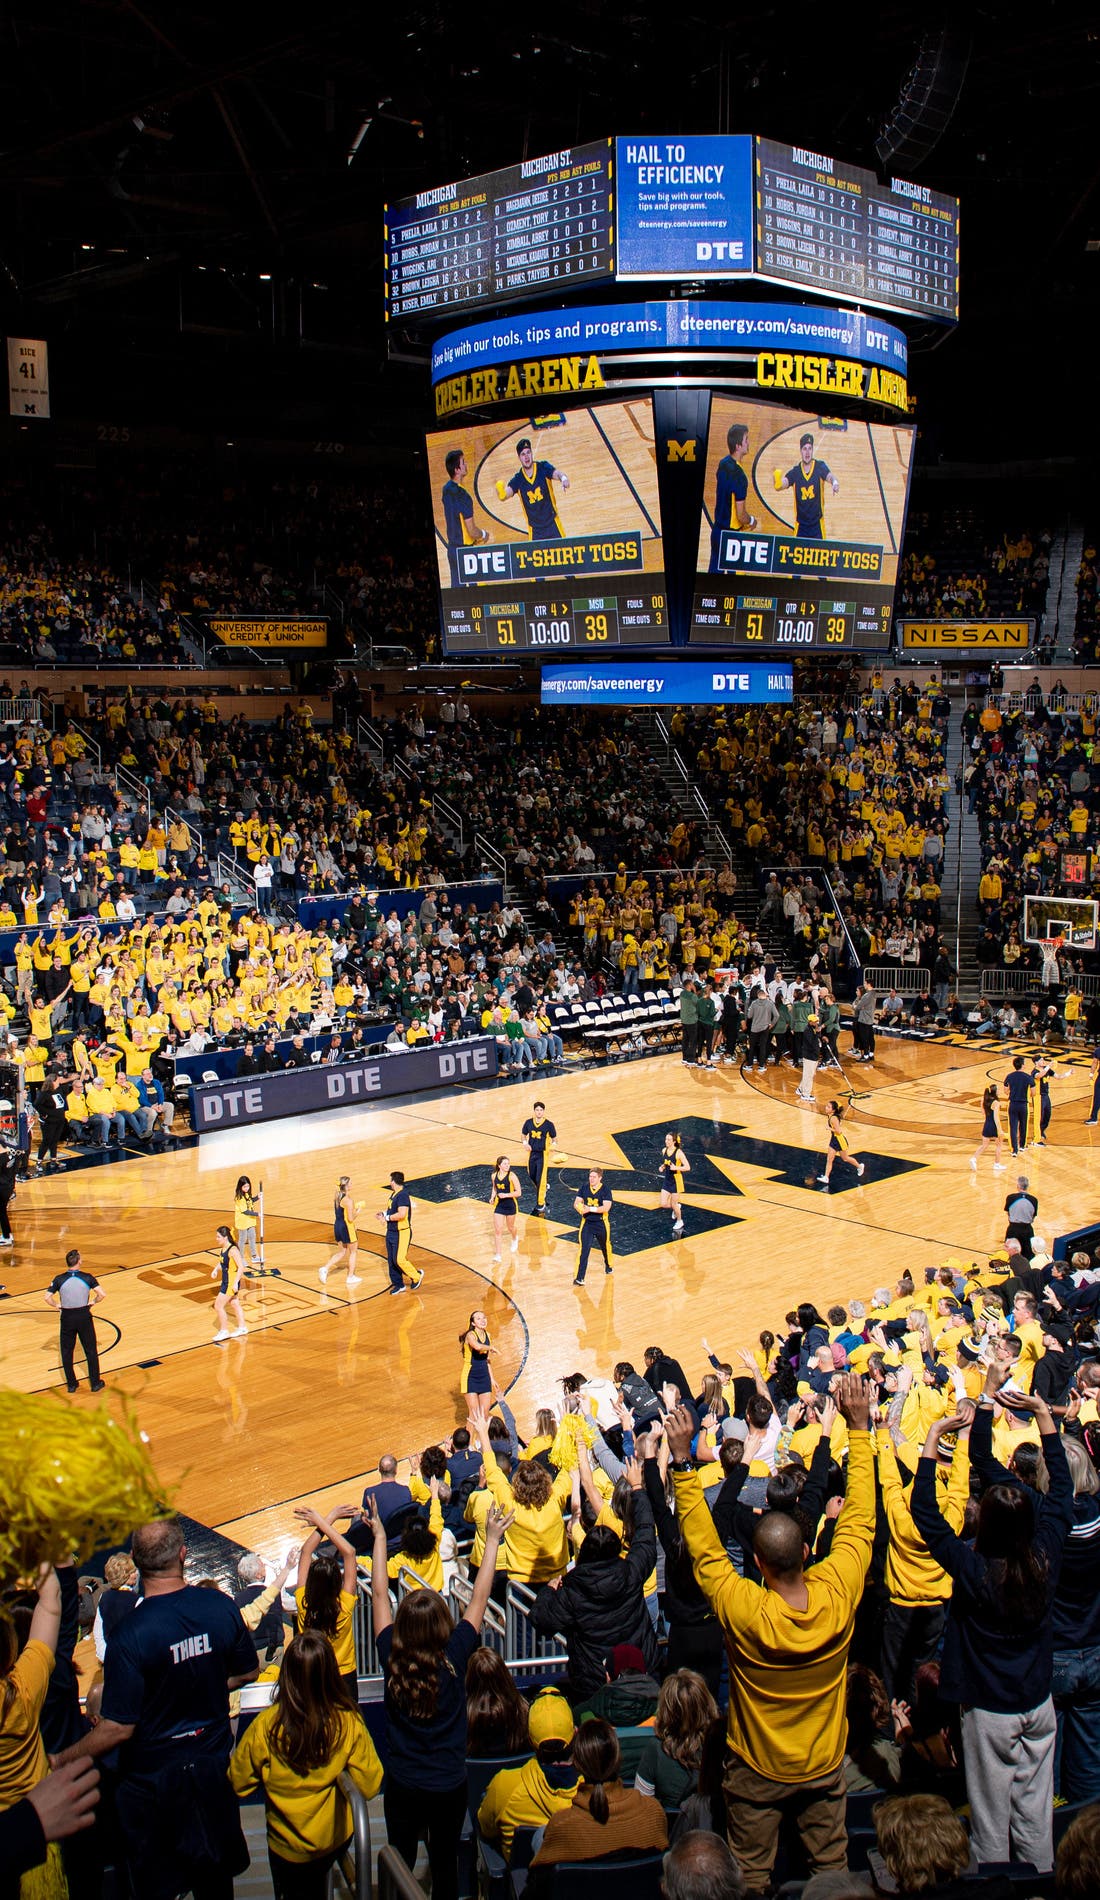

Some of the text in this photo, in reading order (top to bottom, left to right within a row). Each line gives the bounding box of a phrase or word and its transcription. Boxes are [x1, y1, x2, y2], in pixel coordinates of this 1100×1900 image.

[521, 150, 573, 179] MICHIGAN ST.
[626, 145, 685, 164] HAIL TO
[792, 146, 834, 174] MICHIGAN
[547, 173, 558, 184] PTS
[571, 166, 582, 177] AST
[584, 160, 601, 173] FOULS
[638, 165, 724, 185] EFFICIENCY
[416, 183, 457, 209] MICHIGAN
[495, 178, 596, 217] 0 2 2 2 1
[638, 193, 656, 201] Save
[658, 192, 669, 202] big
[671, 192, 688, 200] with
[704, 191, 726, 200] tools,
[765, 174, 769, 186] 5
[818, 190, 825, 201] 10
[829, 193, 834, 204] 3
[841, 196, 845, 208] 2
[851, 199, 856, 211] 2
[890, 177, 932, 204] MICHIGAN ST.
[638, 202, 708, 212] tips and programs.
[391, 234, 396, 244] 5
[441, 219, 449, 230] 10
[453, 216, 458, 228] 3
[465, 213, 469, 224] 2
[476, 210, 481, 221] 2
[495, 225, 499, 236] 1
[533, 211, 549, 225] TORY
[553, 210, 558, 220] 2
[565, 206, 570, 218] 2
[578, 203, 582, 214] 1
[591, 200, 597, 211] 2
[638, 220, 727, 229] dteenergy.com/saveenergy
[495, 244, 500, 254] 2
[553, 228, 558, 240] 0
[565, 225, 570, 237] 0
[578, 222, 583, 233] 0
[591, 219, 597, 230] 0
[495, 261, 500, 271] 5
[552, 246, 560, 258] 12
[565, 244, 570, 255] 5
[579, 240, 583, 251] 1
[592, 237, 597, 248] 0
[696, 242, 744, 261] DTE
[496, 278, 503, 290] 14
[554, 265, 559, 276] 6
[565, 262, 570, 273] 8
[579, 259, 584, 270] 0
[592, 256, 598, 267] 0
[680, 314, 853, 344] dteenergy.com/saveenergy
[866, 330, 889, 352] DTE
[434, 319, 662, 368] Save big with our tools, tips and programs.
[19, 362, 36, 379] 41
[757, 352, 864, 397] CRISLER
[435, 355, 606, 417] CRISLER ARENA
[24, 404, 36, 414] M
[667, 440, 696, 462] M
[526, 486, 544, 504] M
[800, 484, 815, 500] M
[463, 541, 638, 575] DTE T-SHIRT TOSS
[725, 539, 880, 571] DTE T-SHIRT TOSS
[489, 603, 520, 615] MICHIGAN
[534, 603, 557, 617] QTR 4
[588, 599, 604, 610] MSU
[626, 595, 664, 609] FOULS 00
[701, 597, 734, 610] FOULS 00
[742, 597, 773, 609] MICHIGAN
[785, 602, 806, 616] QTR 4
[862, 606, 890, 618] FOULS 00
[451, 607, 481, 619] FOULS 00
[622, 612, 662, 625] TIME OUTS 3
[695, 613, 731, 626] TIME OUTS 4
[211, 623, 326, 633] UNIVERSITY OF MICHIGAN
[448, 621, 481, 634] TIME OUTS 4
[497, 620, 517, 645] 51
[529, 621, 570, 645] 10:00
[585, 614, 608, 641] 39
[746, 614, 764, 640] 51
[776, 619, 814, 643] 10:00
[826, 617, 845, 643] 39
[881, 620, 887, 632] 3
[911, 628, 1021, 643] NISSAN
[229, 633, 305, 641] CREDIT UNION
[712, 674, 750, 691] DTE
[767, 674, 784, 690] HAIL
[1065, 864, 1083, 883] 30
[438, 1048, 489, 1078] DTE
[326, 1066, 382, 1099] DTE
[202, 1088, 263, 1122] DTE
[531, 1130, 542, 1139] M
[587, 1197, 599, 1207] M
[170, 1632, 213, 1665] THIEL
